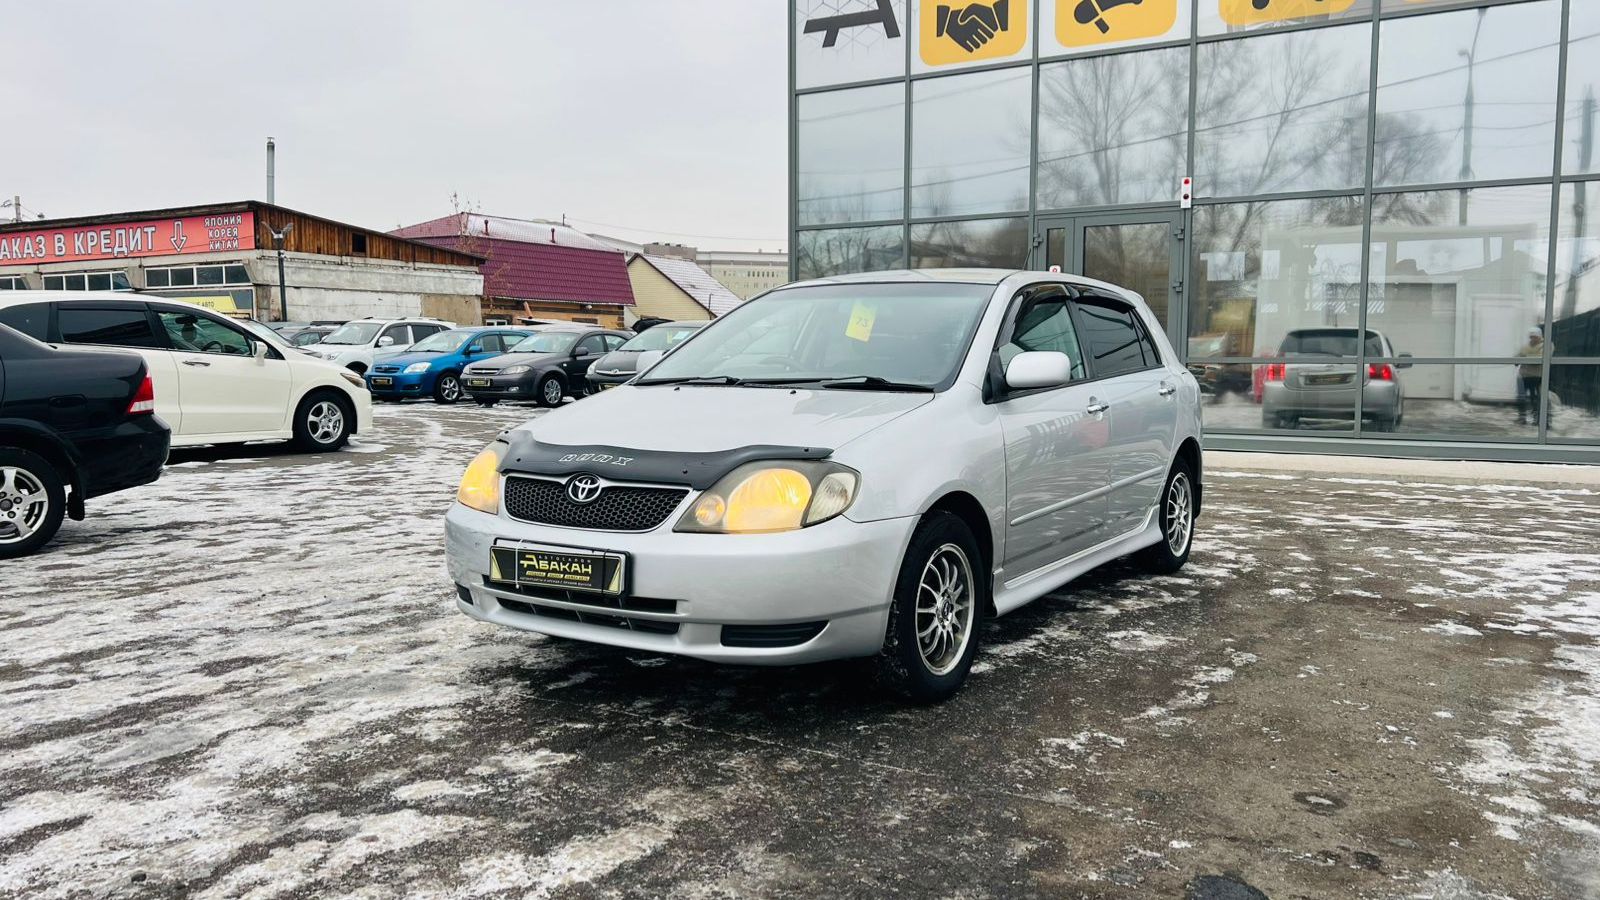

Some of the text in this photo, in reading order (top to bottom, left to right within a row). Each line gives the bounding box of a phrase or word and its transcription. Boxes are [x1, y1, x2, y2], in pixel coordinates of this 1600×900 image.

[204, 215, 242, 227] ЯПОНИЯ
[208, 227, 239, 238] КОРЕЯ
[54, 233, 66, 256] В
[74, 226, 157, 257] КРЕДИТ
[209, 238, 239, 250] КИТАЙ
